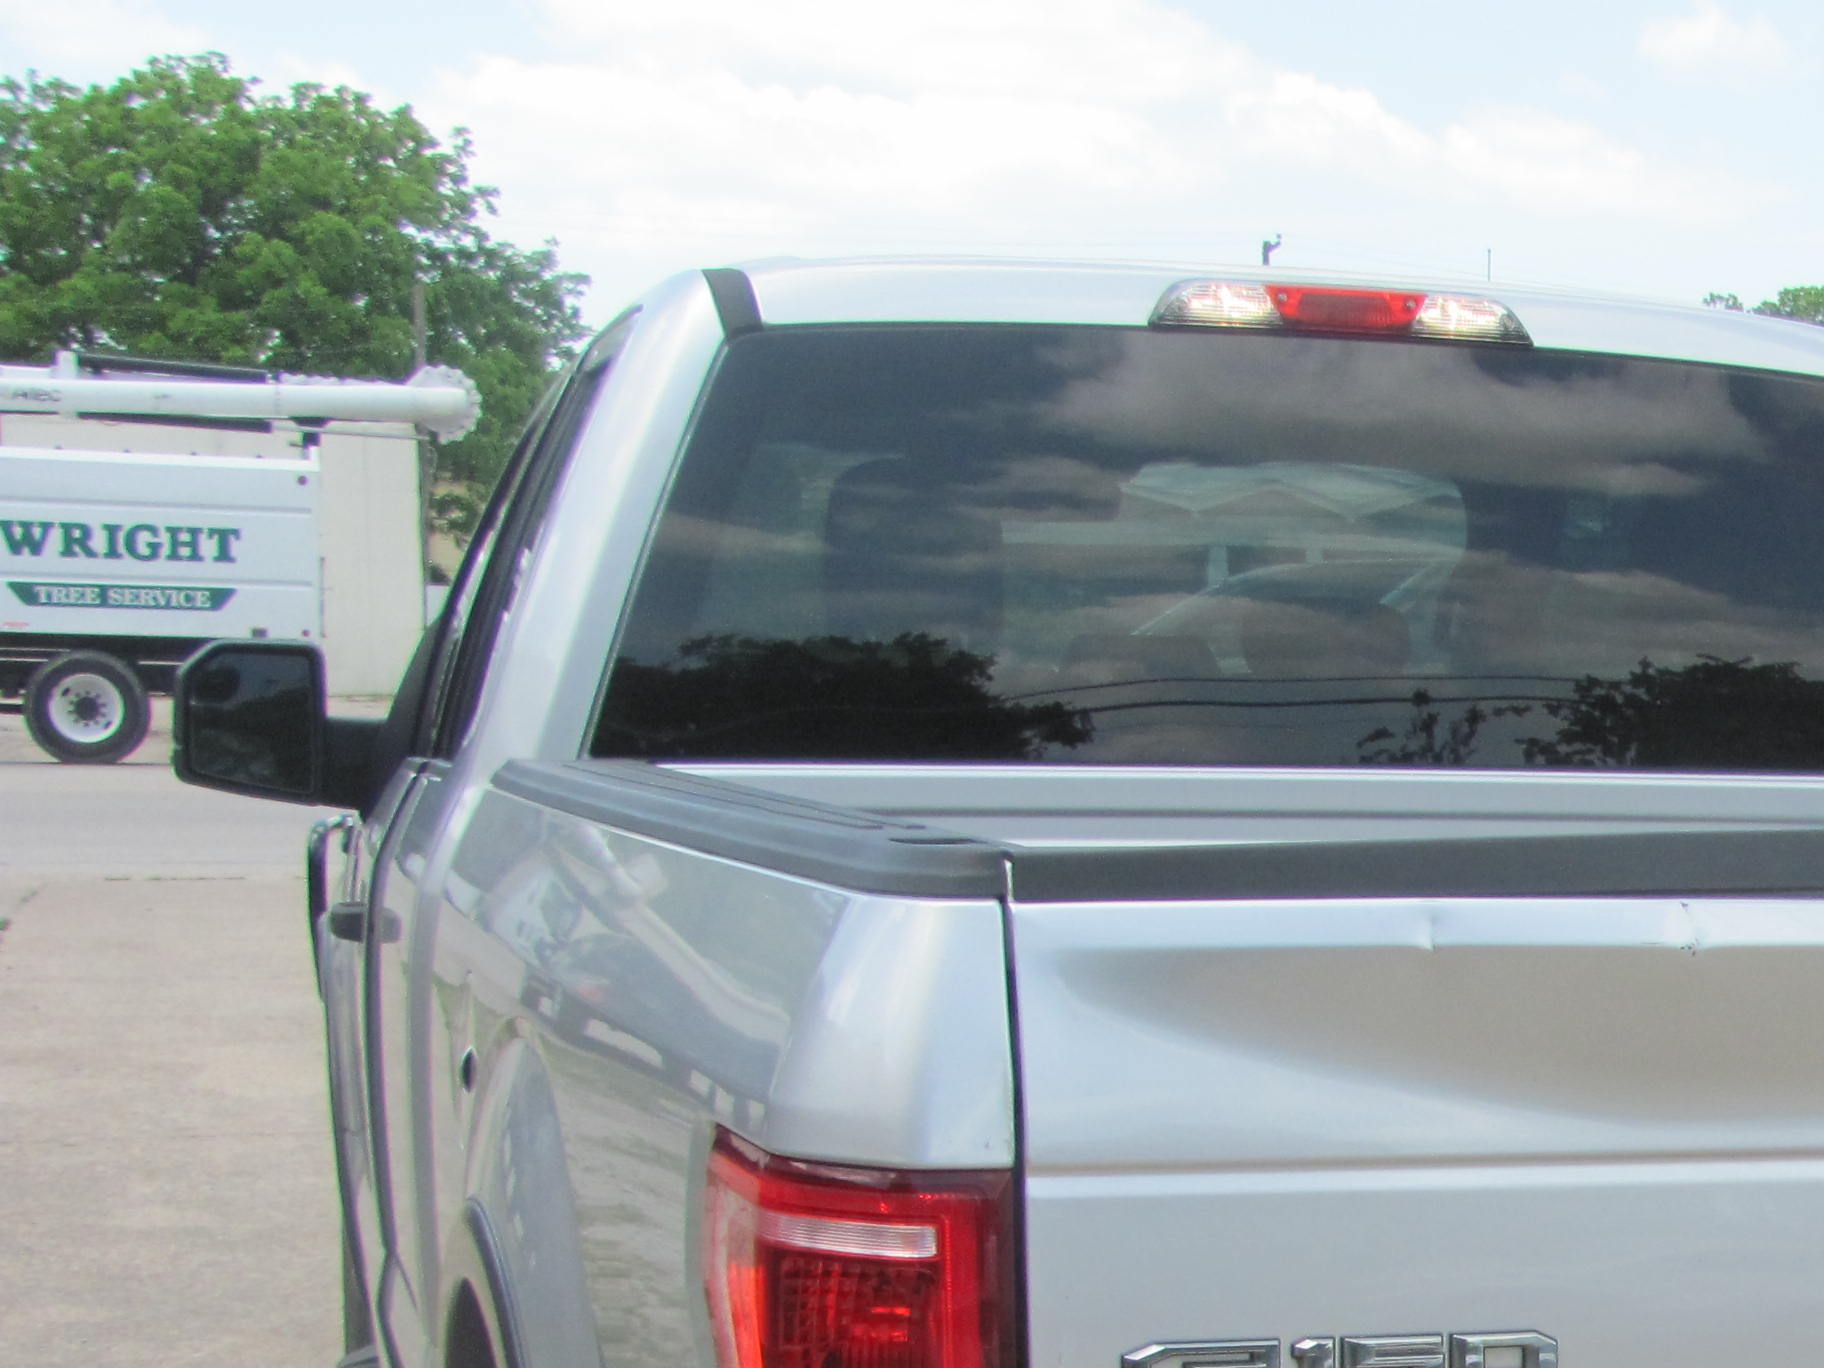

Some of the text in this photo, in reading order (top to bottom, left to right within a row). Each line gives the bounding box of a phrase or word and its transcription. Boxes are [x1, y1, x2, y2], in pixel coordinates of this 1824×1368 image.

[0, 519, 240, 563] WRIGHT
[34, 586, 211, 609] TREE SERVICE
